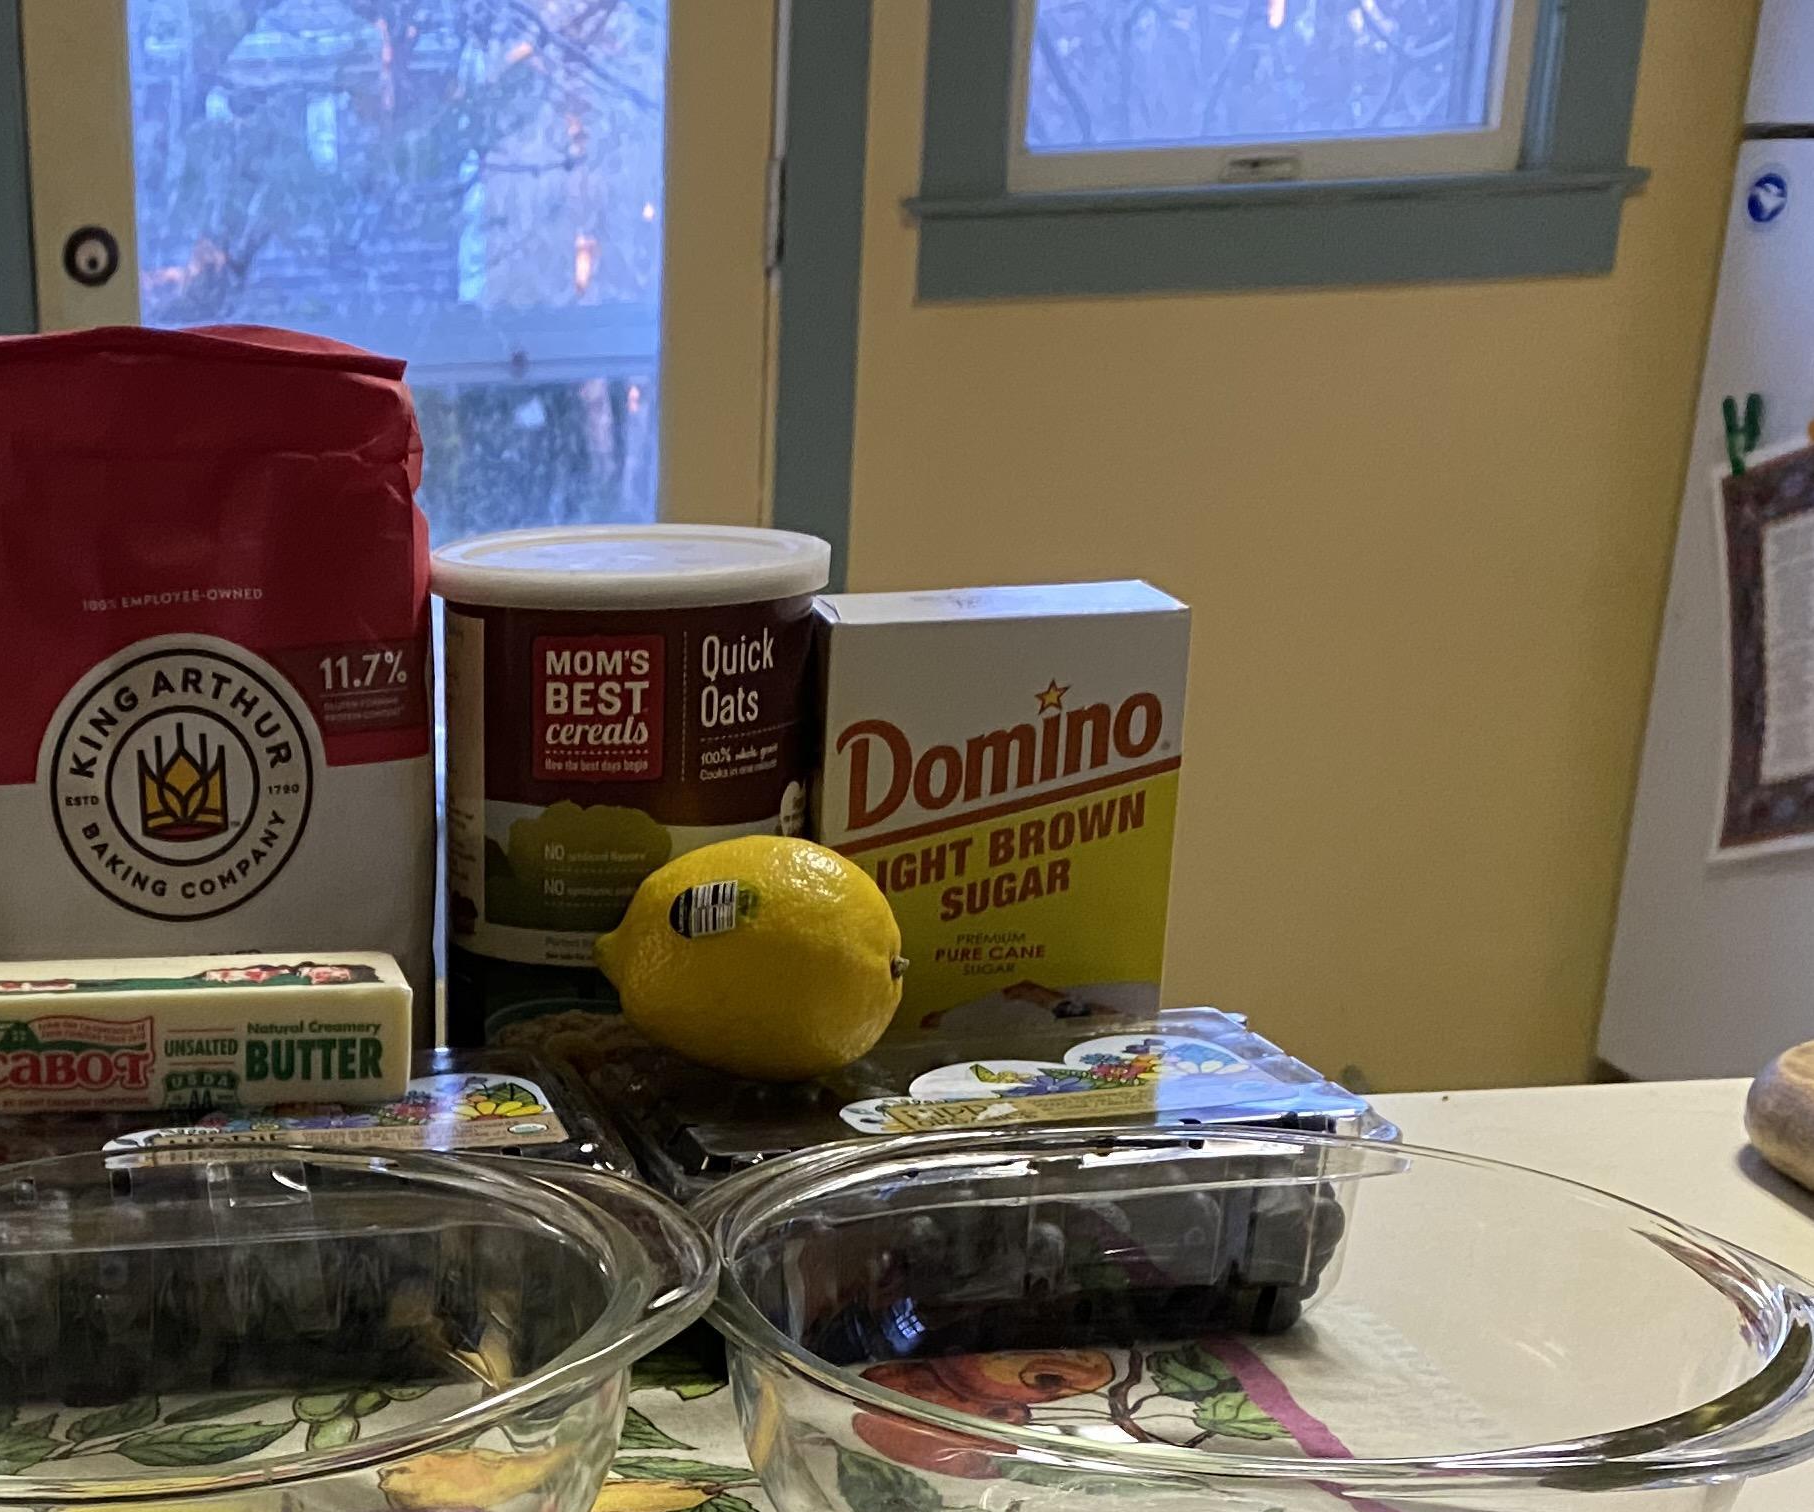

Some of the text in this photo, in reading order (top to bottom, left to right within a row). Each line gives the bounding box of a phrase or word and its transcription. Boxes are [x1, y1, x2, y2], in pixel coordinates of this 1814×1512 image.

[121, 588, 262, 609] EMPLOYEE-OWNED
[319, 649, 407, 690] 11.7%
[545, 649, 650, 677] MOM'S
[701, 626, 774, 681] Quick
[545, 681, 650, 716] BEST
[701, 685, 759, 728] Oats
[69, 667, 292, 779] KING ARTHUR
[545, 715, 649, 745] cereals
[701, 746, 731, 765] 100%
[836, 678, 1163, 832] Domino
[82, 810, 286, 899] BAKING COMPANY
[876, 790, 1146, 894] IGHT BROWN
[940, 858, 1071, 921] SUGAR
[935, 945, 1046, 961] PURE CANE
[956, 932, 1027, 945] PREMIUM
[962, 963, 1015, 976] SUGAR
[247, 1020, 383, 1038] Natural Creamery
[164, 1037, 239, 1057] UNSALTED
[245, 1037, 383, 1081] BUTTER
[170, 1073, 230, 1089] USDA
